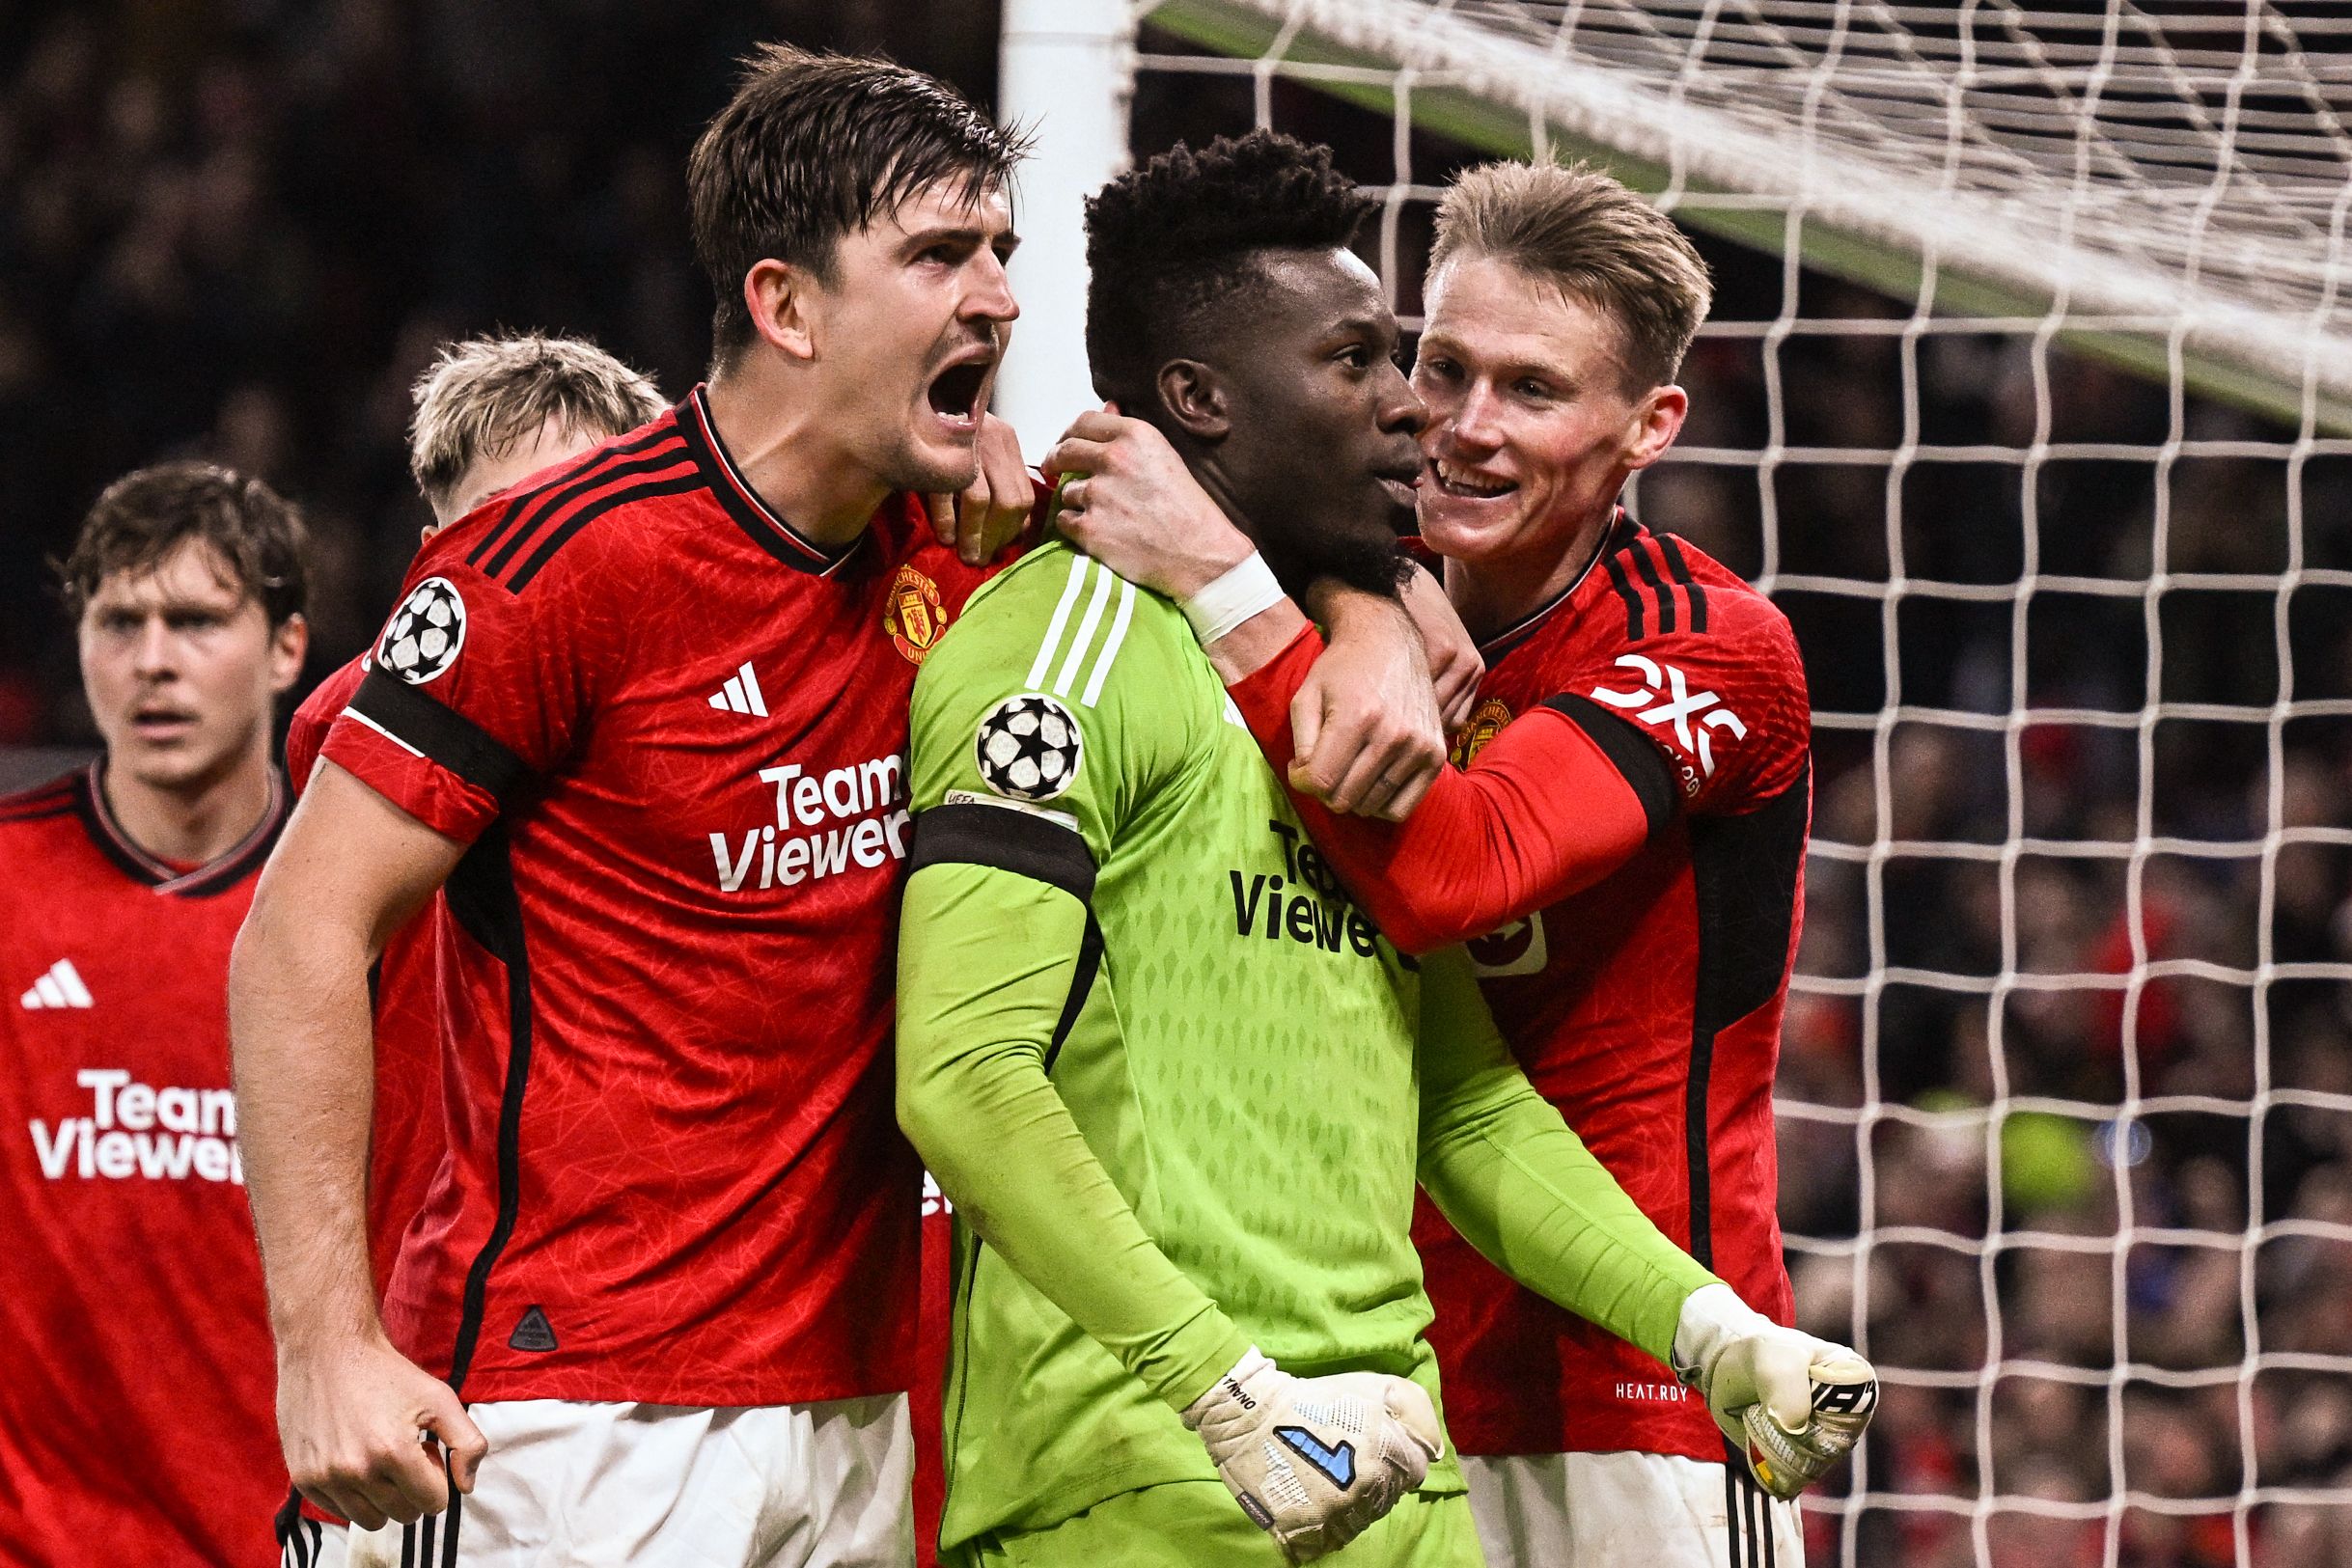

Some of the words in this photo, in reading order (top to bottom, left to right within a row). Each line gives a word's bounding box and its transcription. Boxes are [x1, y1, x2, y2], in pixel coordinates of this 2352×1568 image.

[887, 571, 935, 608] MANCHESTER
[907, 647, 927, 662] UNI
[758, 755, 902, 831] Team
[948, 794, 975, 804] UEFA
[708, 809, 911, 893] Viewer
[1230, 869, 1380, 958] Viewe
[1222, 1377, 1257, 1410] ONANA
[1616, 1383, 1687, 1402] HEAT.RDY
